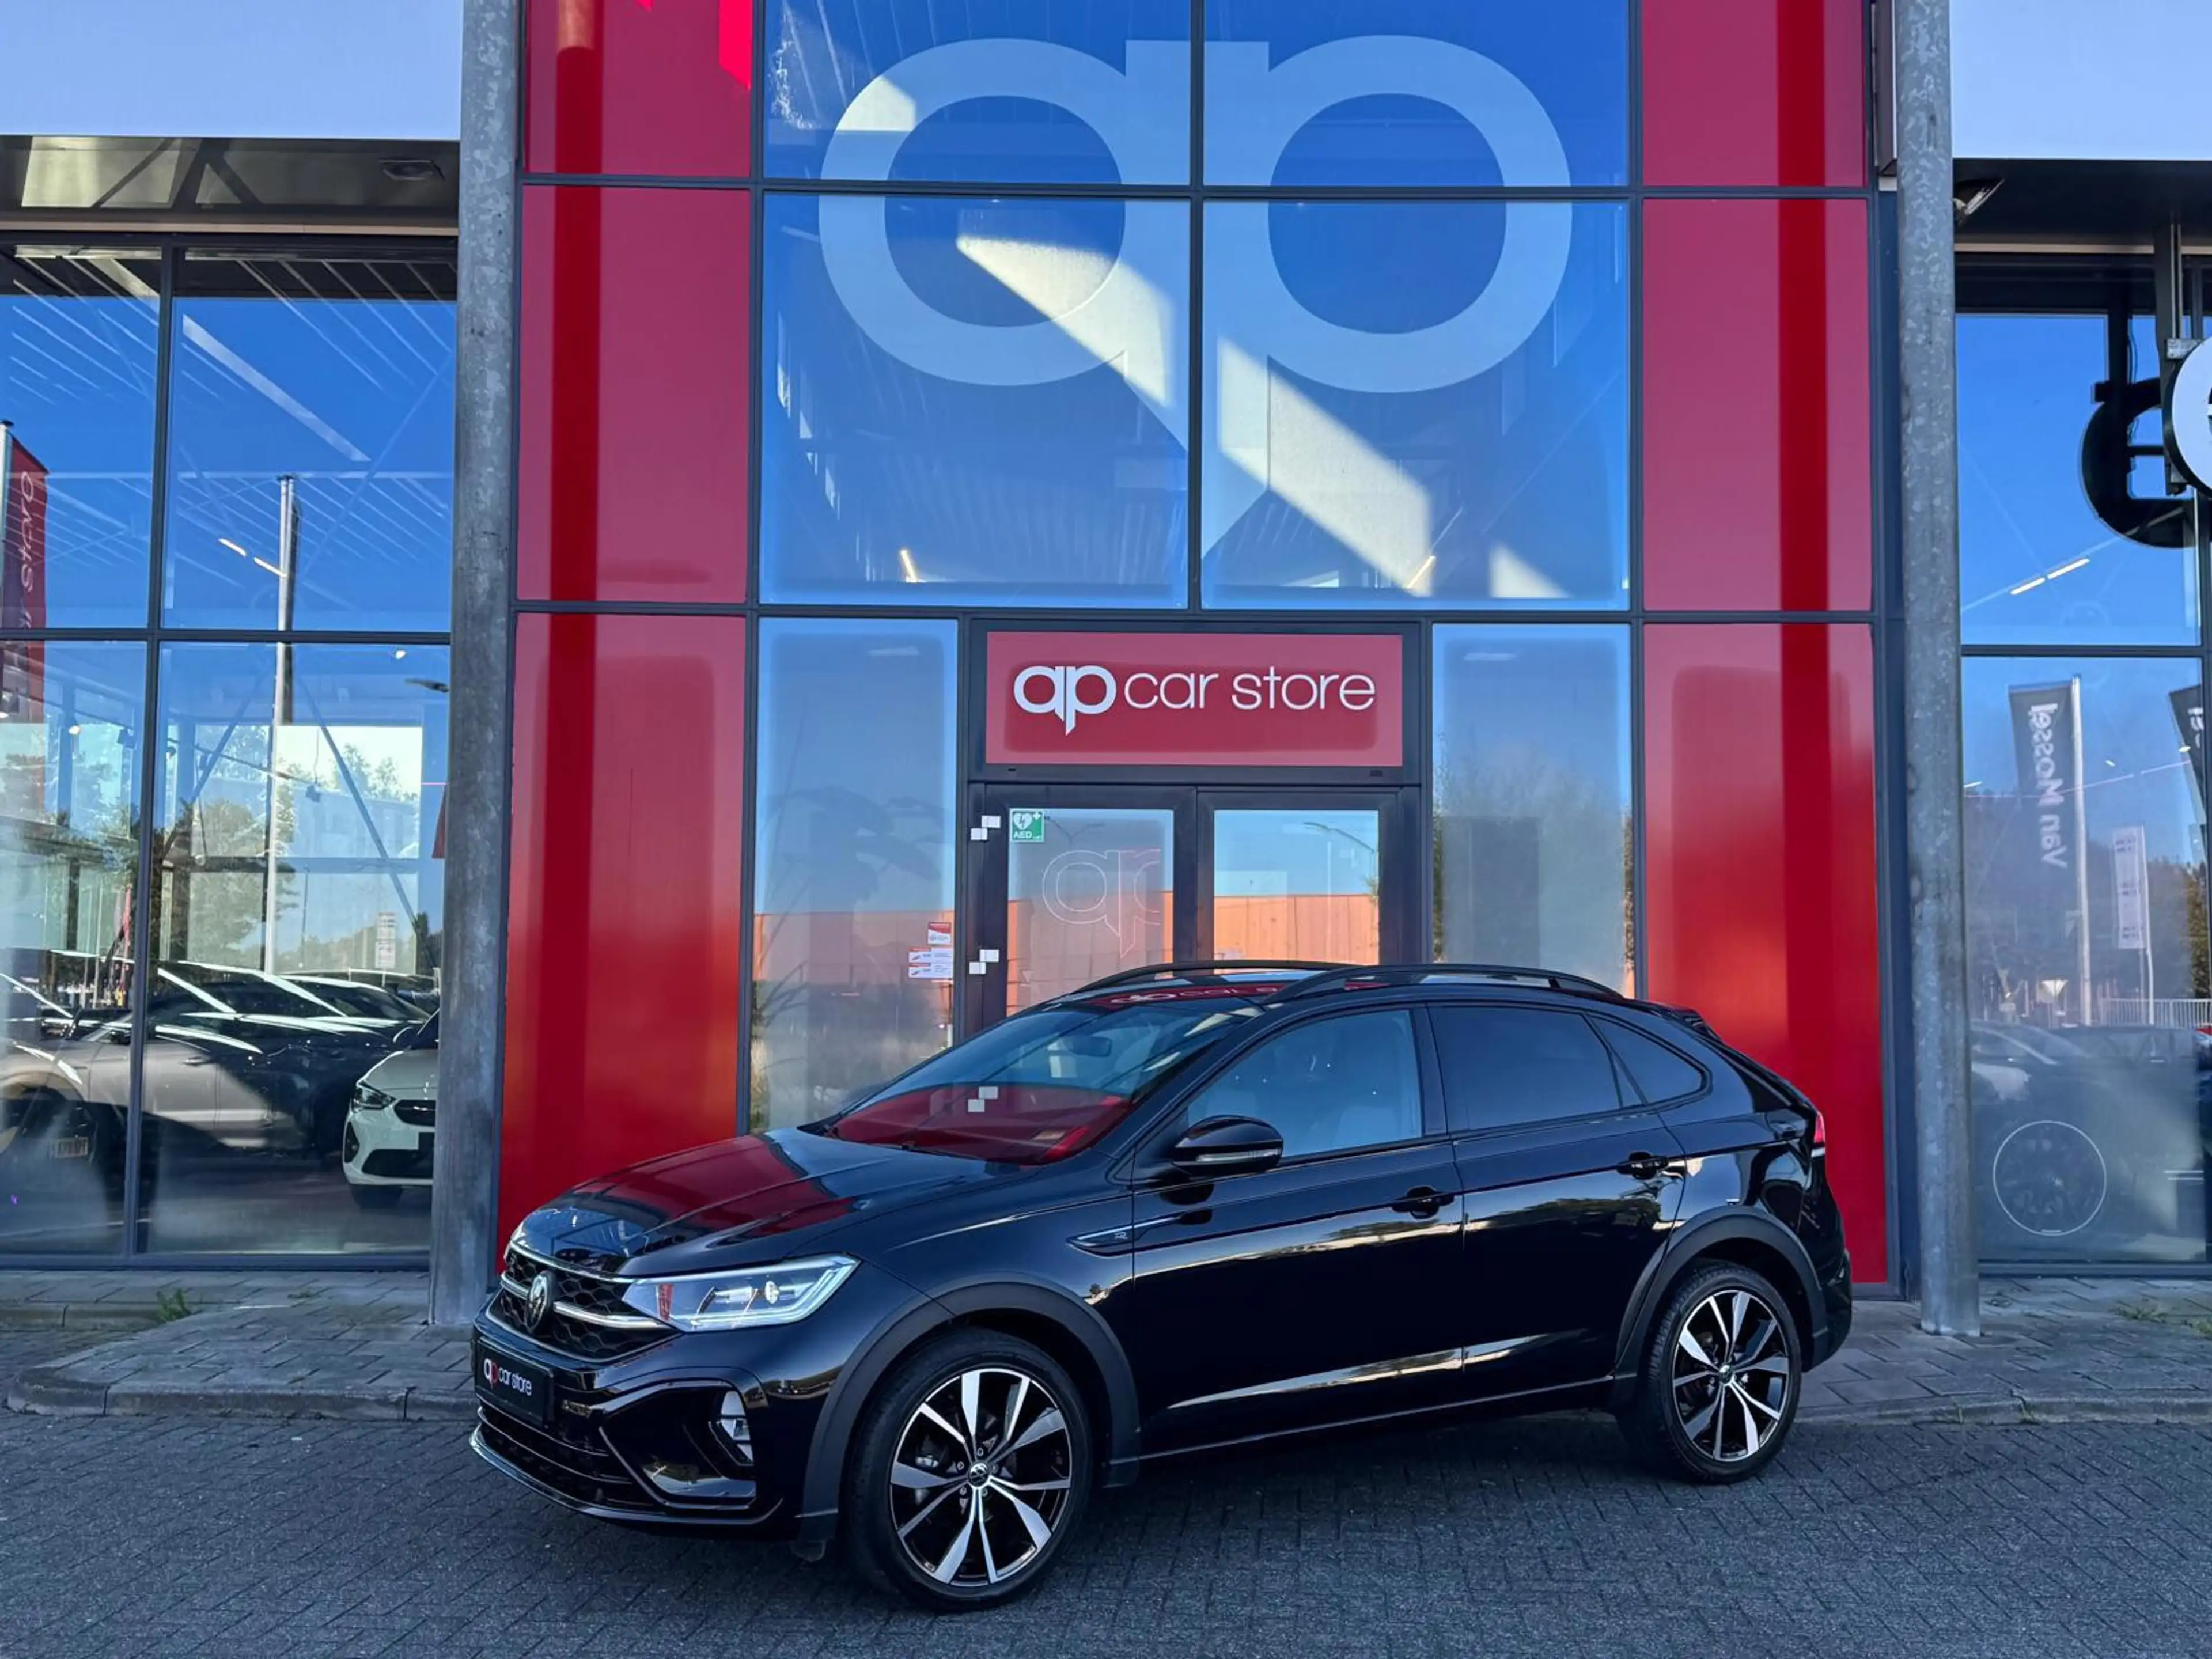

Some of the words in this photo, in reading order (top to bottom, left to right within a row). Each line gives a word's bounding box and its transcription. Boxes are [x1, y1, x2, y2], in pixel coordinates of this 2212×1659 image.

[819, 35, 1572, 560] ap
[1013, 665, 1117, 736] ap
[1124, 672, 1219, 709] car
[1232, 666, 1376, 710] store
[1014, 830, 1033, 839] AED
